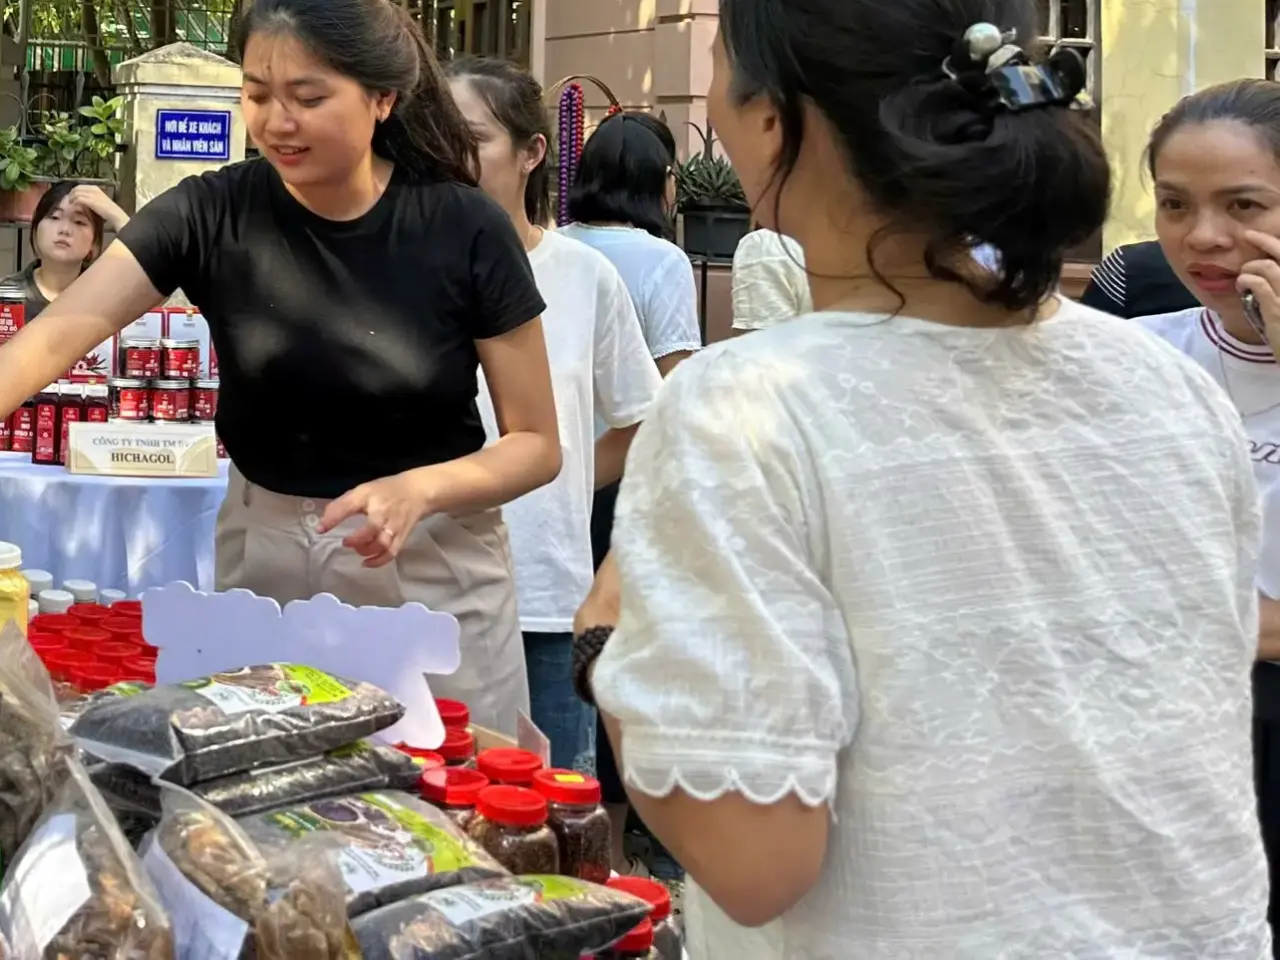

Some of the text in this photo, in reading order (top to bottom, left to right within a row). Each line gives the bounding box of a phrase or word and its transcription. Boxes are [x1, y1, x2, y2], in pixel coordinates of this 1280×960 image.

[188, 121, 198, 134] XE
[92, 436, 119, 447] CÔNG
[121, 438, 133, 447] TY
[135, 438, 160, 448] TNHH
[111, 451, 175, 465] HICHAGOL
